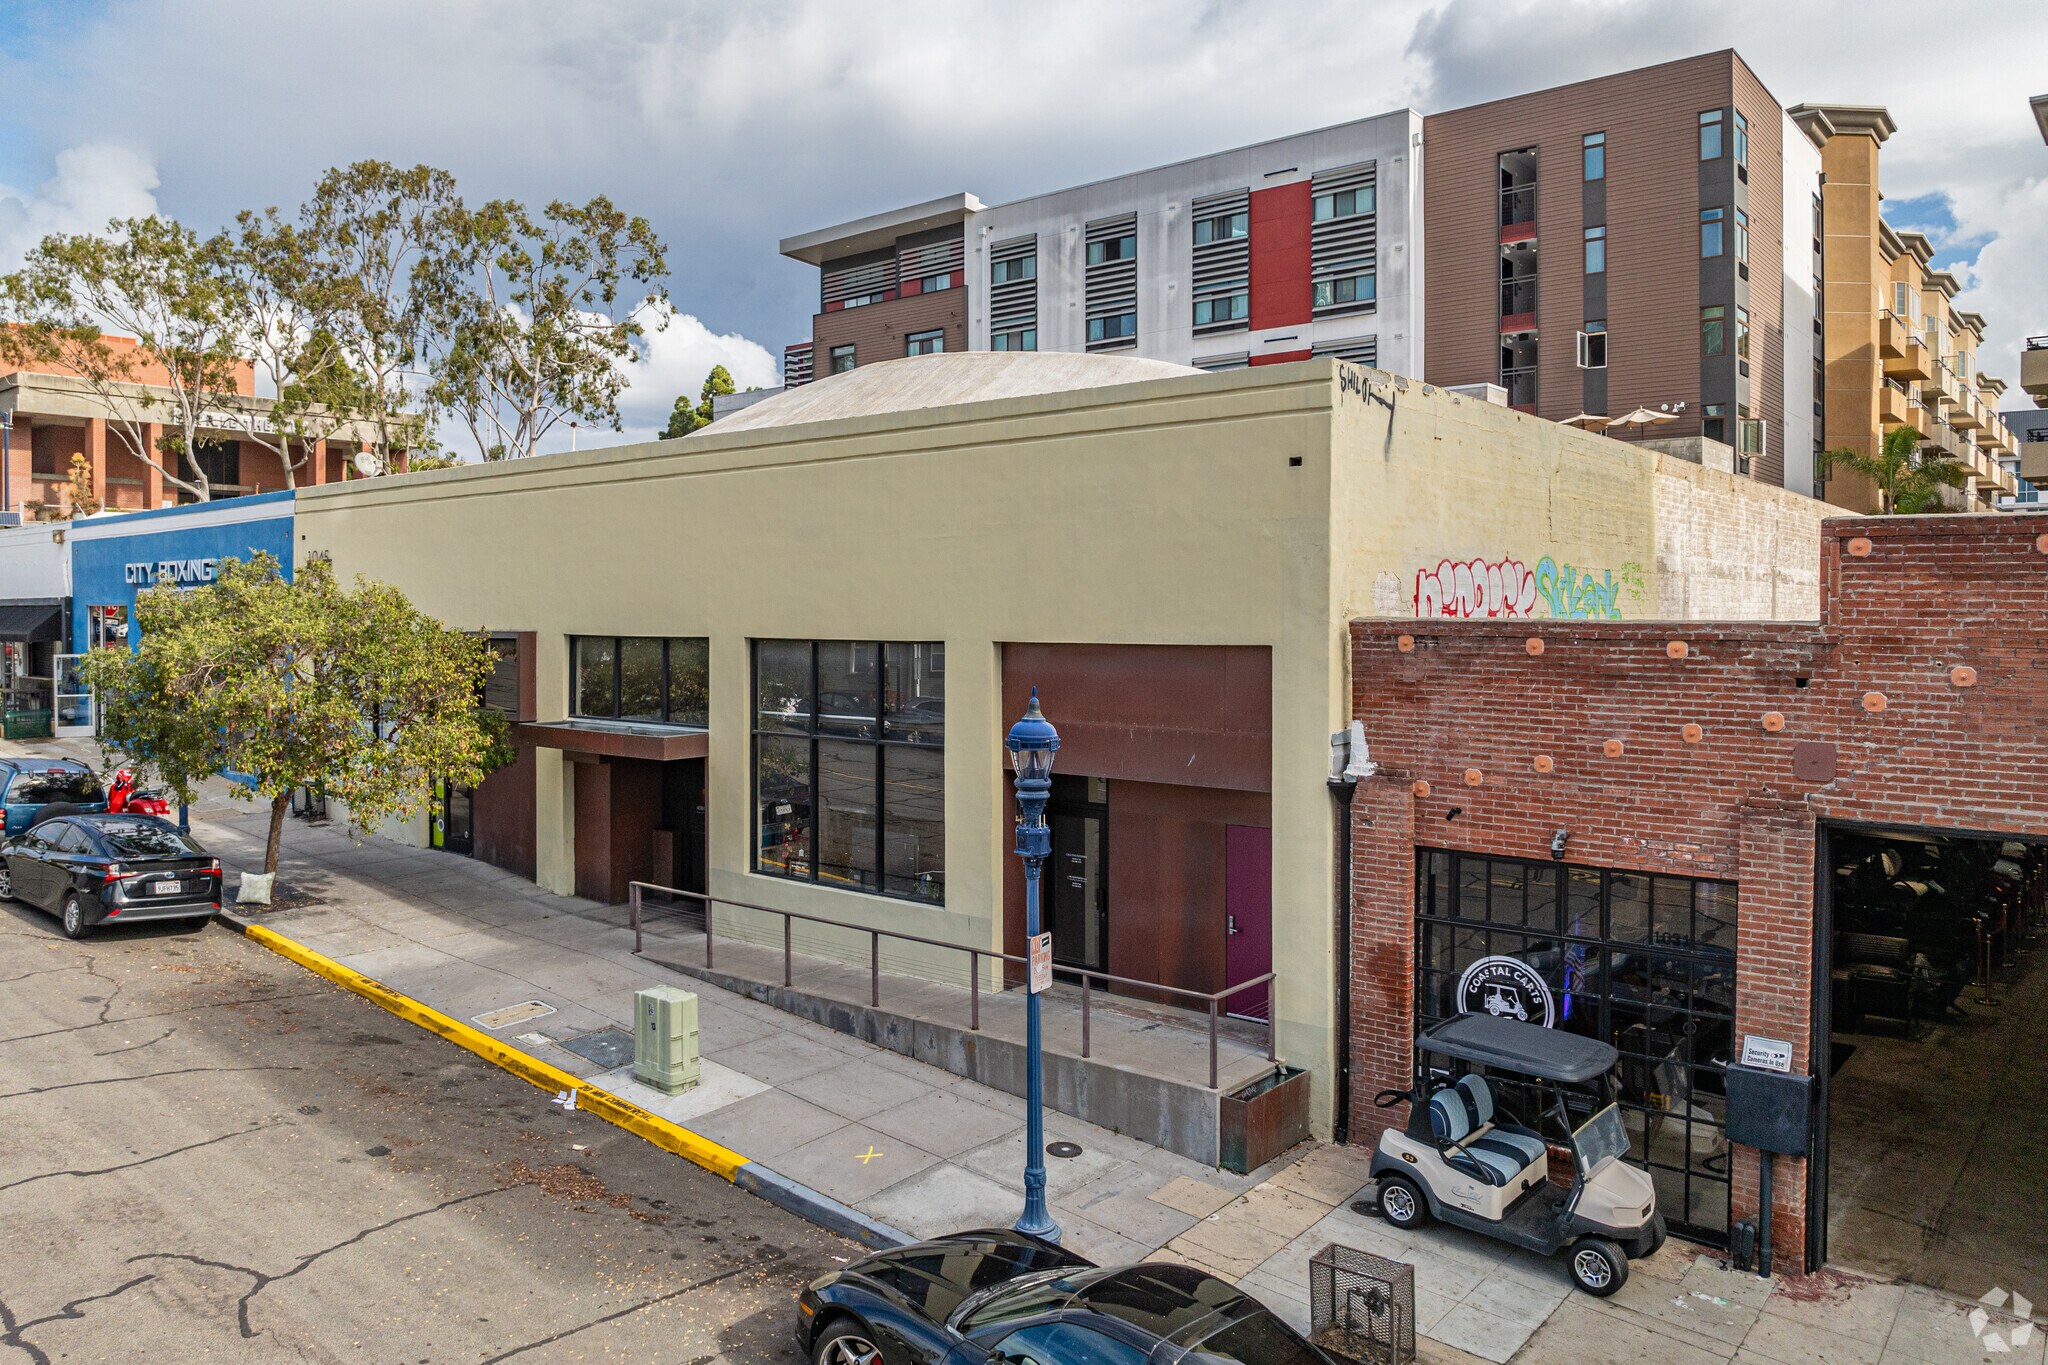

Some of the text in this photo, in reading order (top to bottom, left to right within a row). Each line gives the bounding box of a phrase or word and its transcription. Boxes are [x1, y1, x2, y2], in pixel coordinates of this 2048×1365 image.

[125, 559, 213, 584] CITY BOXING
[1469, 966, 1542, 1004] COASTAL CARTS
[1747, 1056, 1768, 1065] Cameras
[1775, 1060, 1785, 1068] Use
[1748, 1048, 1770, 1058] Security
